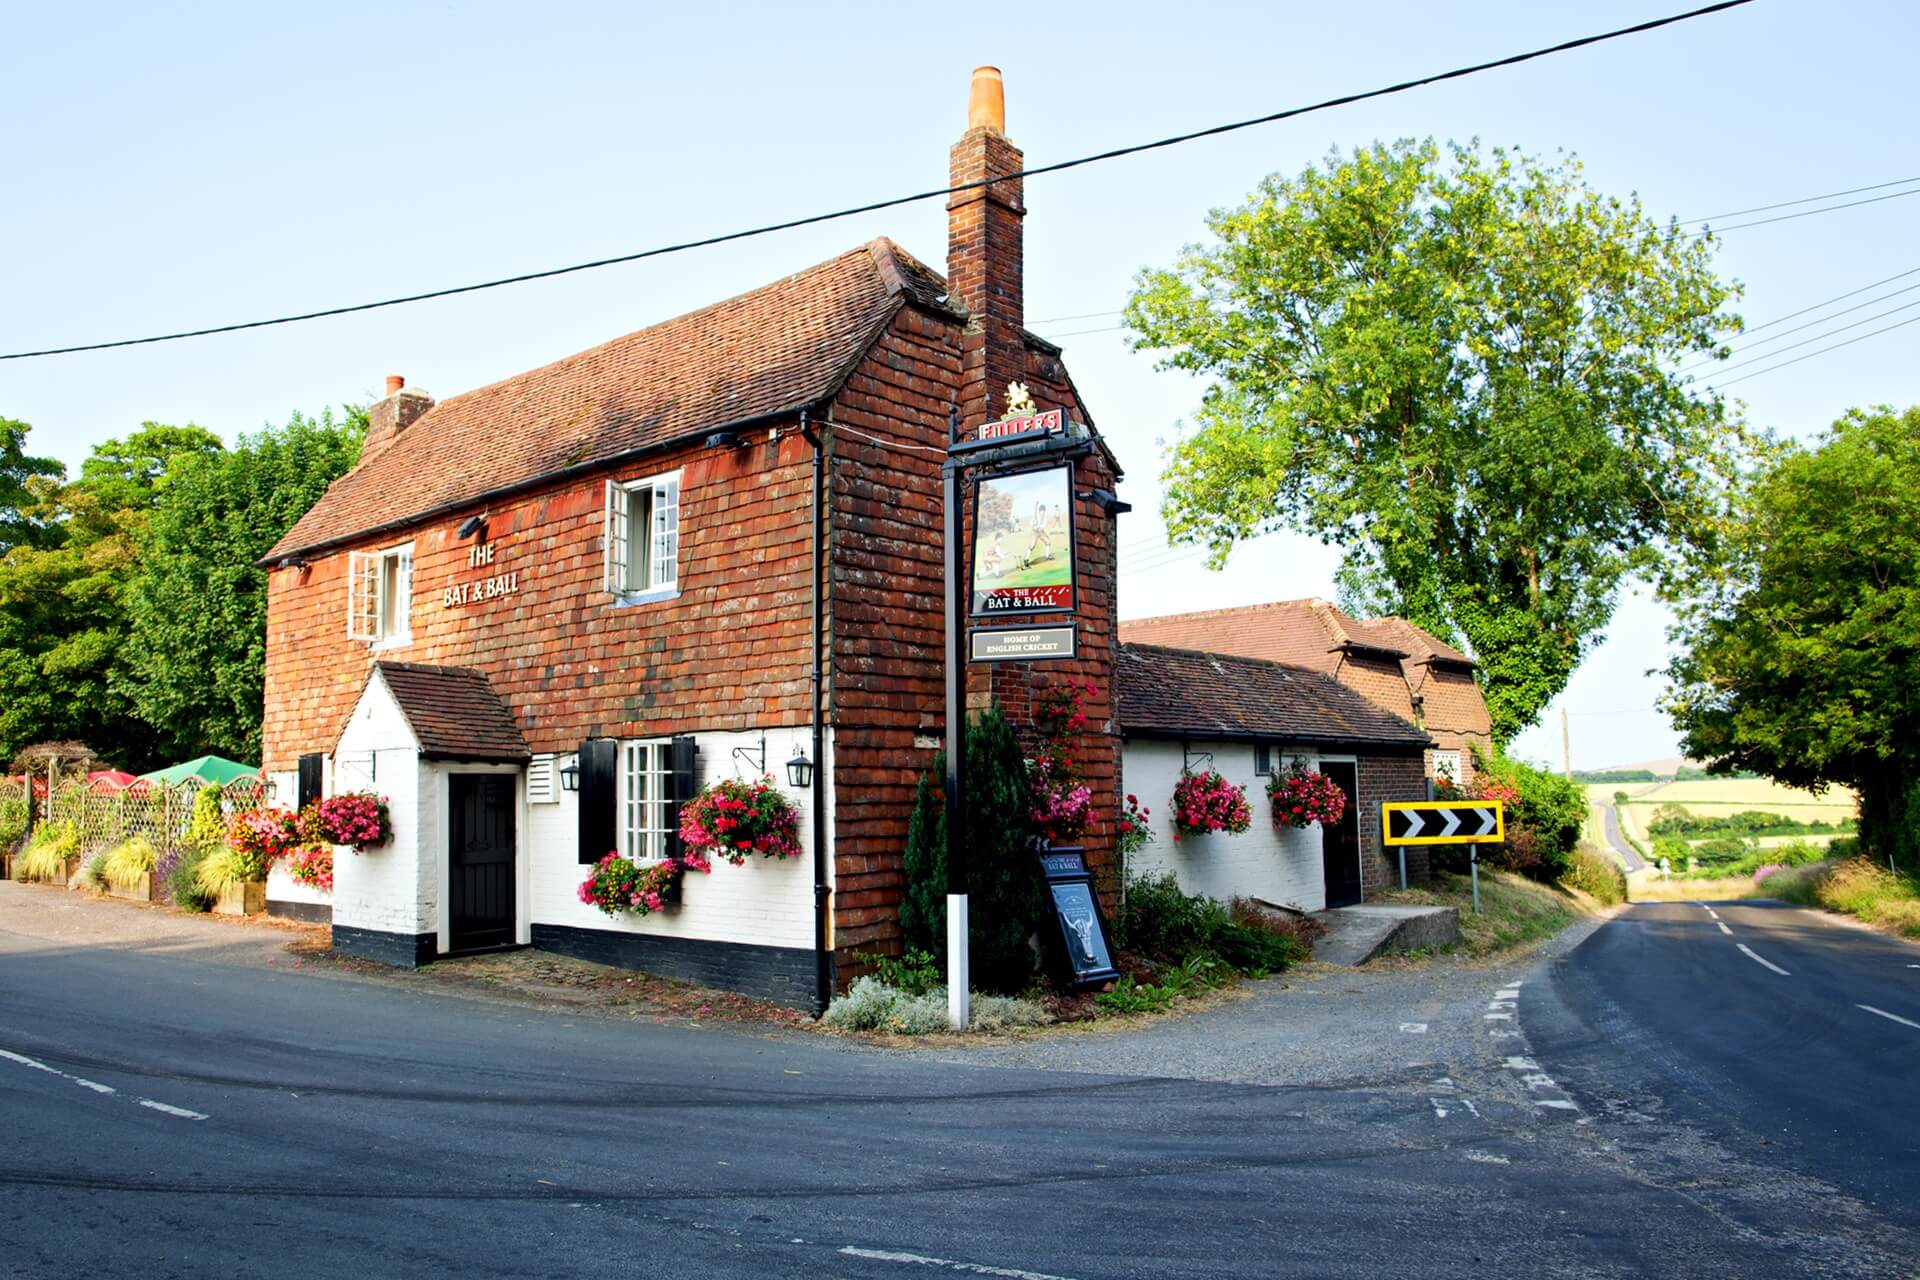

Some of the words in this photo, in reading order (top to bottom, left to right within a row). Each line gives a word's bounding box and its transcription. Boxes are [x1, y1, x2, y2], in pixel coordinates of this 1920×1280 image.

[469, 544, 494, 567] THE
[444, 584, 469, 607] BAT
[473, 582, 483, 601] &
[487, 572, 518, 598] BALL
[1013, 588, 1029, 596] THE
[988, 598, 1011, 609] BAT
[1013, 597, 1022, 607] &
[1025, 595, 1056, 607] BALL
[1003, 635, 1028, 644] HOME
[1029, 634, 1041, 643] OF
[986, 644, 1022, 653] ENGLISH
[1023, 642, 1058, 651] CRICKET
